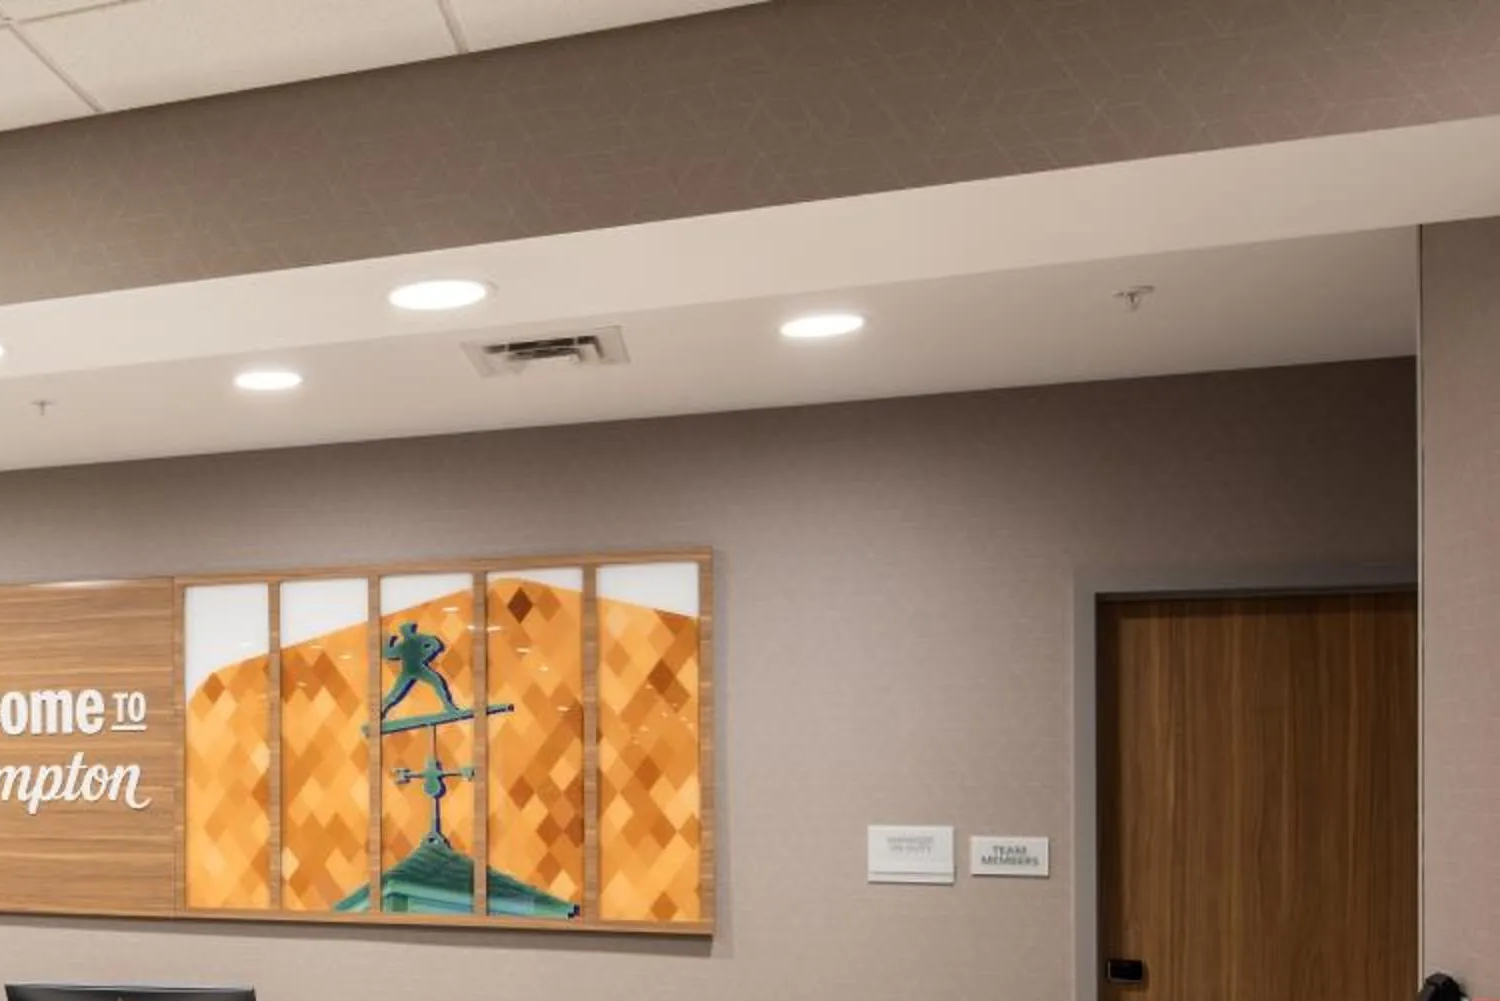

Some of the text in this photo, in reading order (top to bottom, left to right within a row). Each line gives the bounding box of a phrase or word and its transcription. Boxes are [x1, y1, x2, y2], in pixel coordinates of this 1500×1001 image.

[111, 690, 147, 723] TO
[992, 845, 1027, 855] TEAM
[981, 855, 1040, 867] MEMBERS
